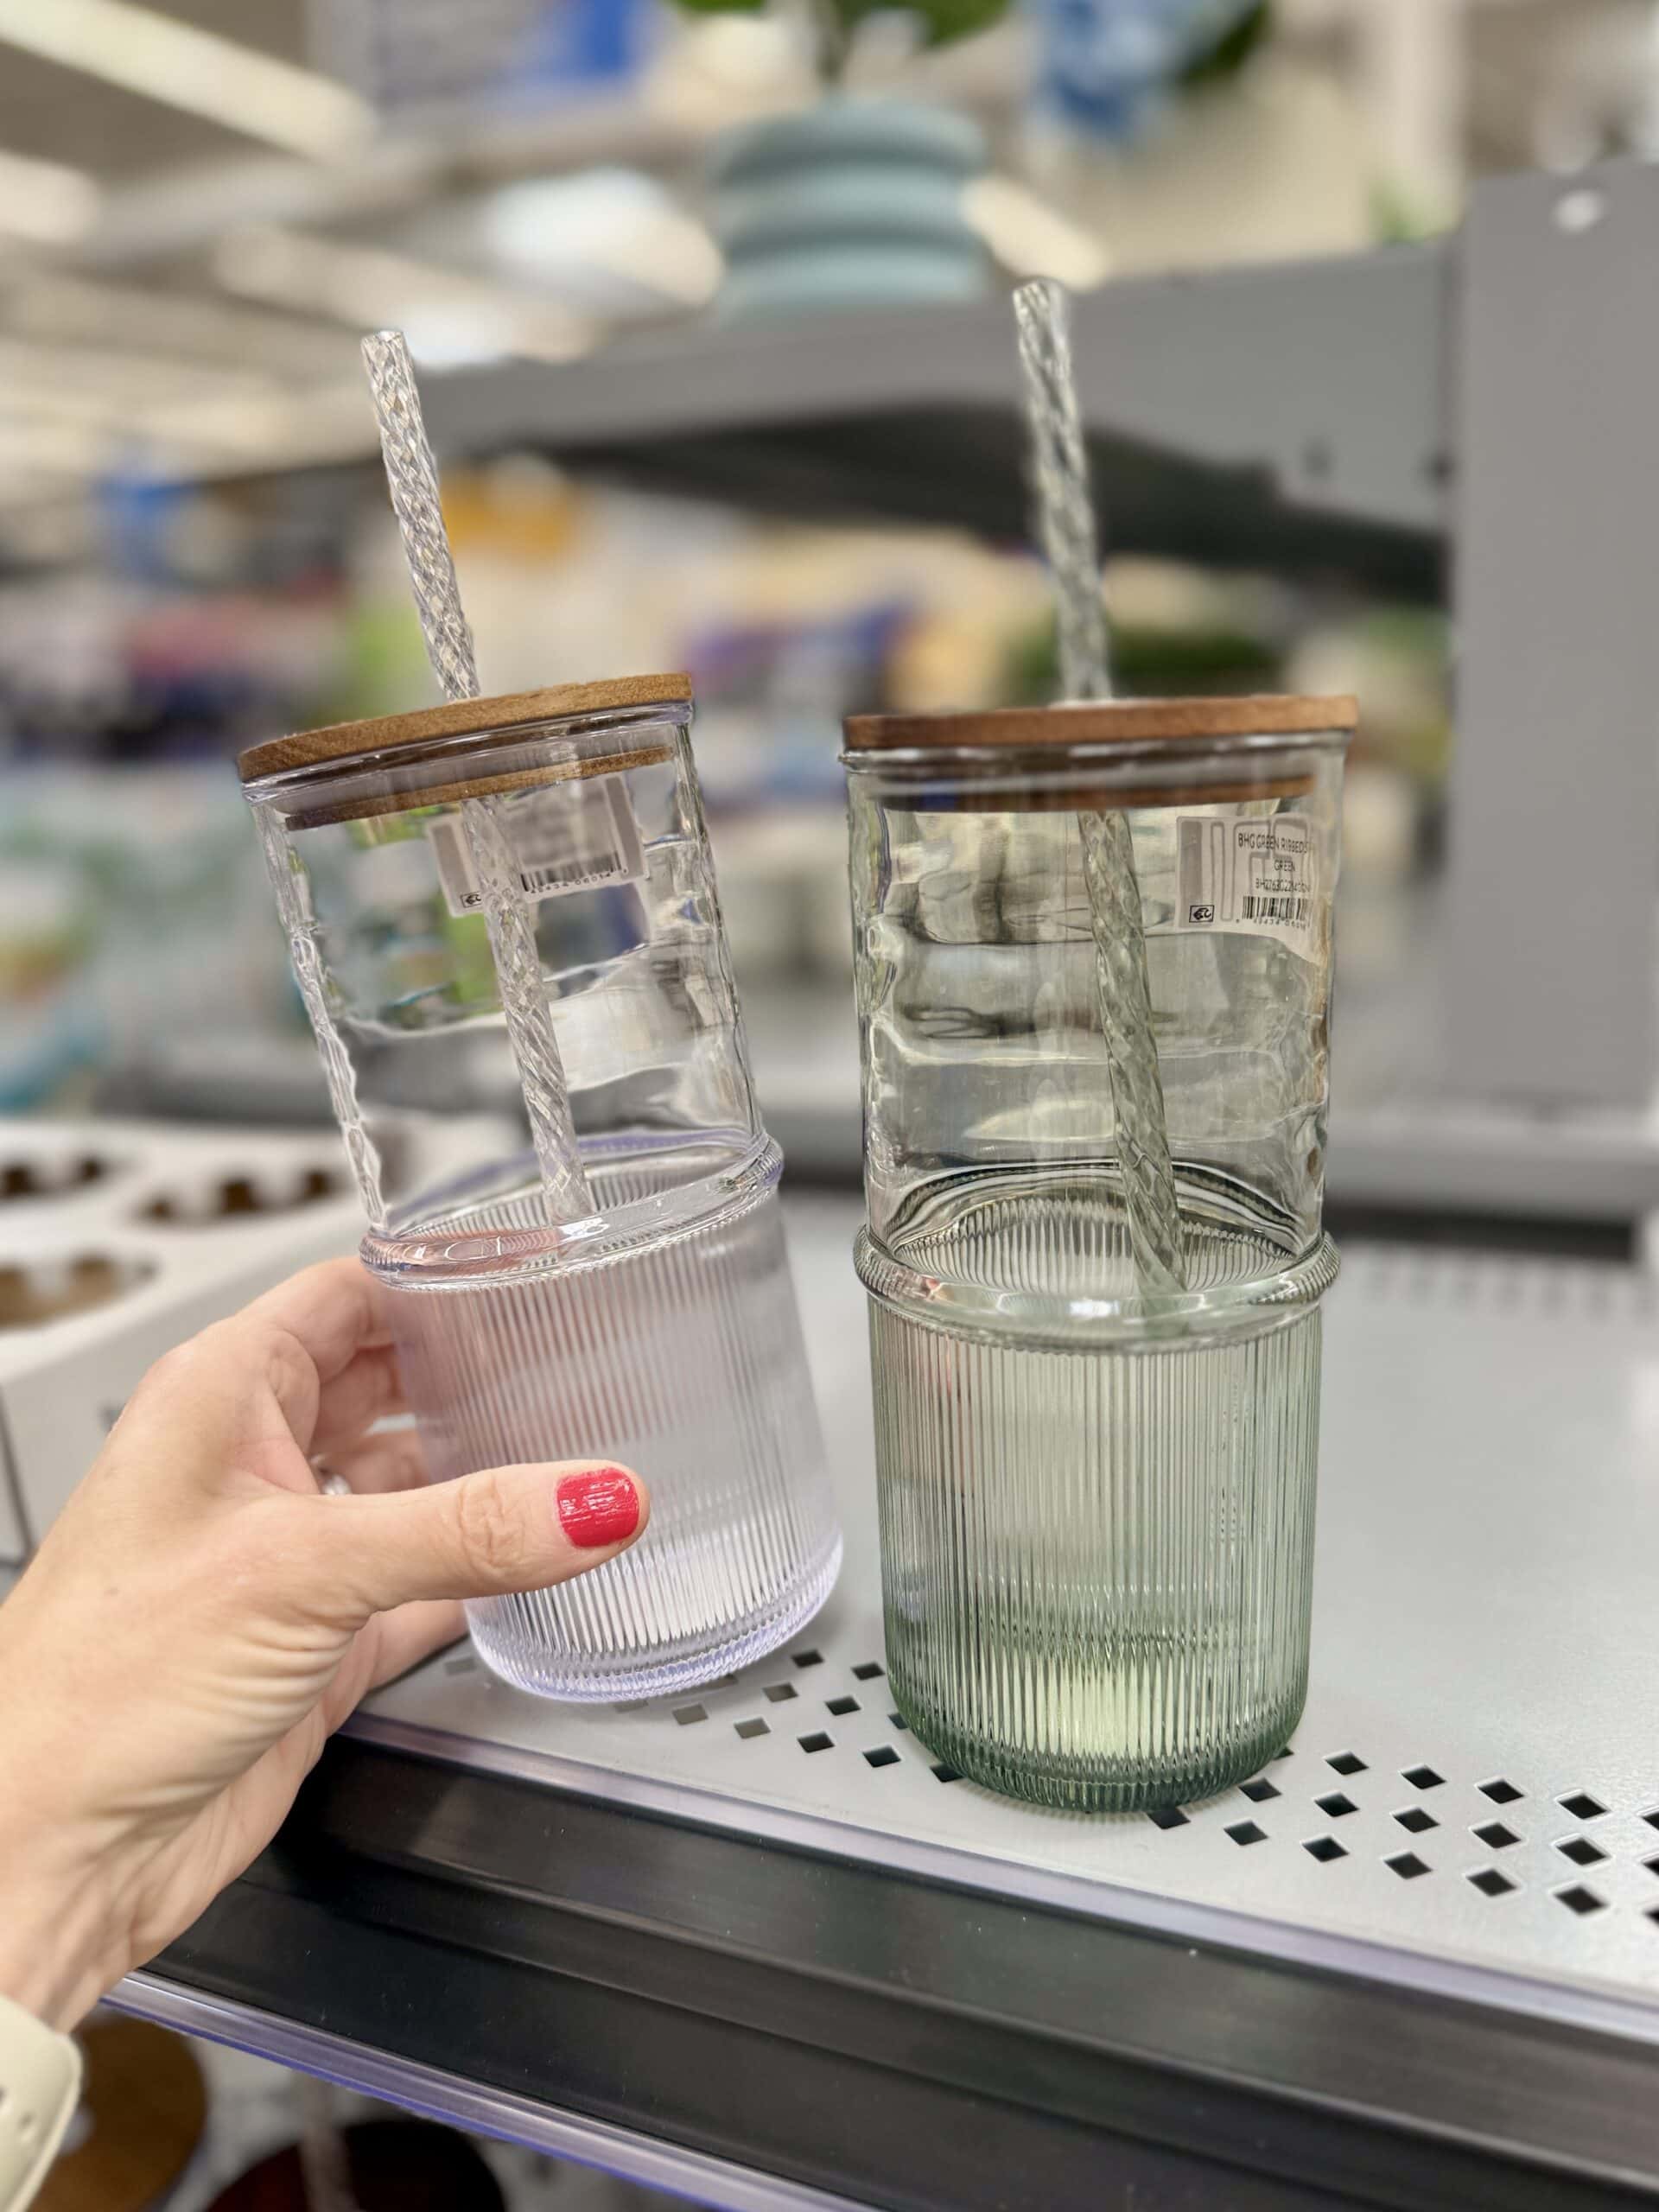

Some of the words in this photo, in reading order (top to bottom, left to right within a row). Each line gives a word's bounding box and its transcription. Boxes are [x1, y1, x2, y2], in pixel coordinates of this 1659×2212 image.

[1238, 832, 1255, 849] BHG
[1256, 834, 1280, 851] GREEN
[1274, 859, 1295, 872] GREEN
